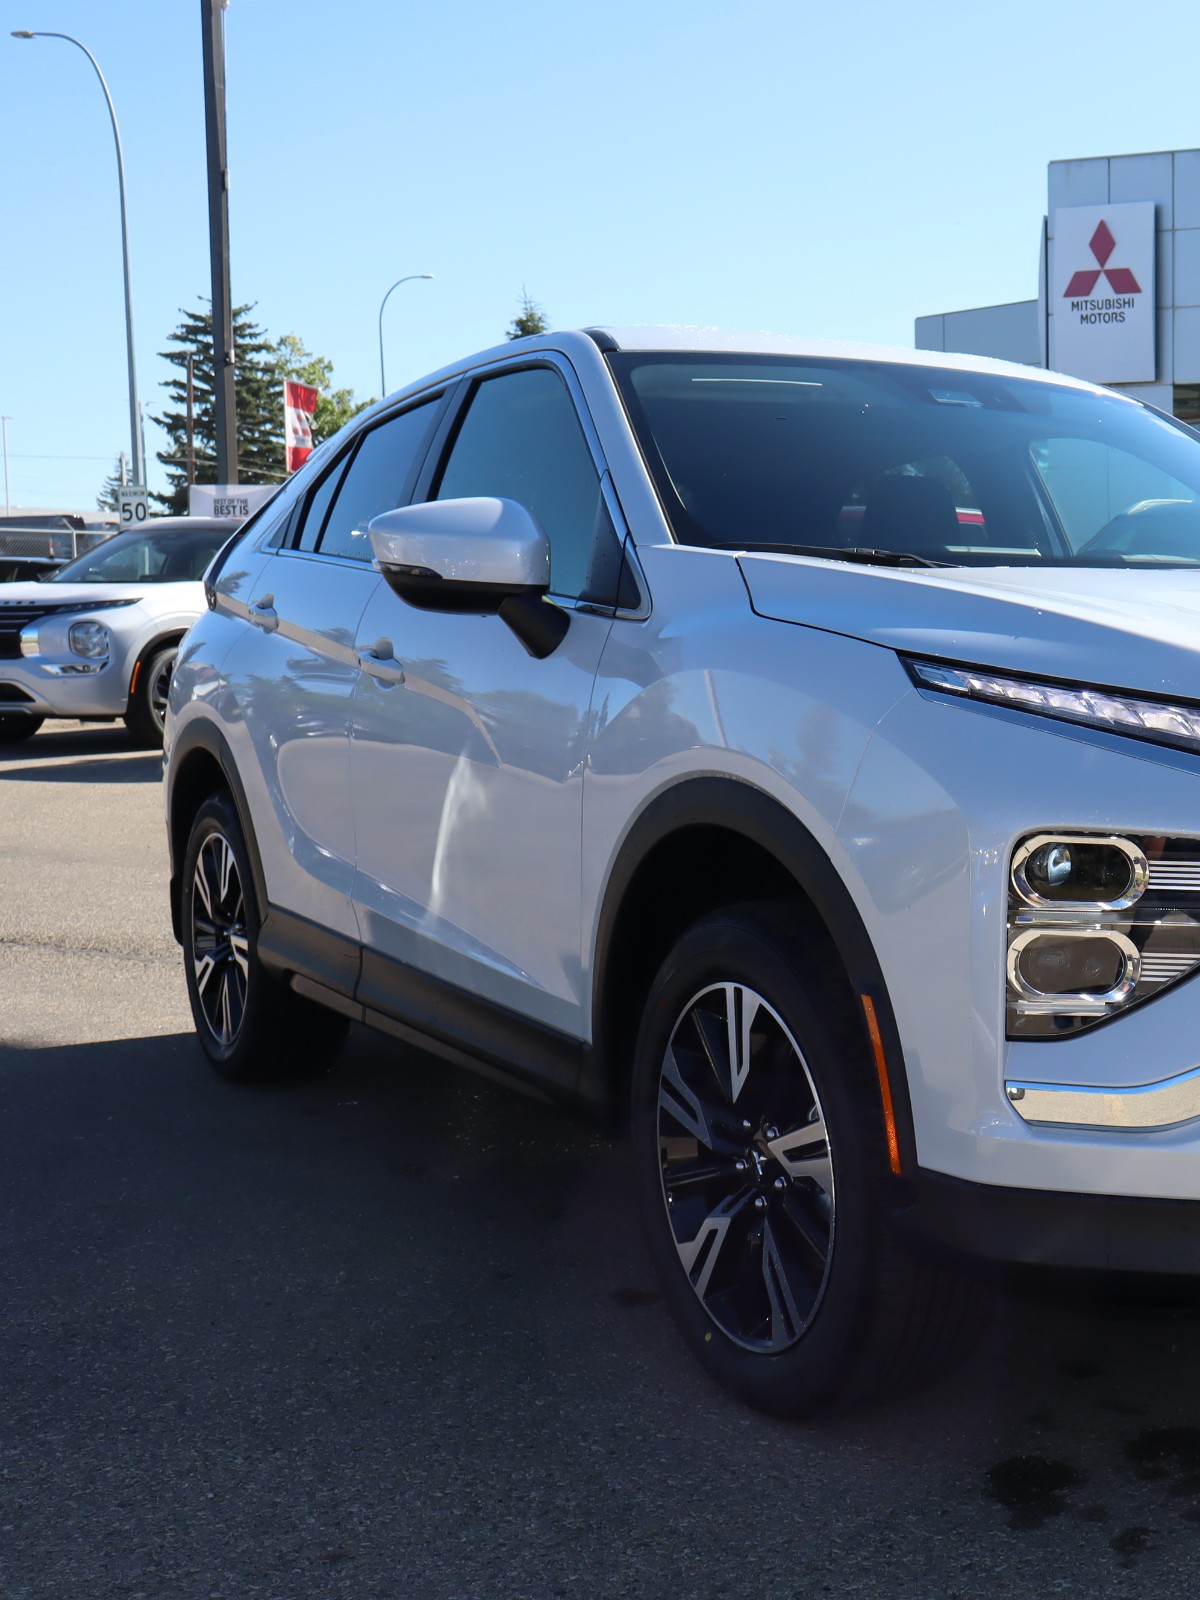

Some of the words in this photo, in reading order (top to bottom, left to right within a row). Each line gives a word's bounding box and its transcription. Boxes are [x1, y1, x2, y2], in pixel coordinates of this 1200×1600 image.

[1071, 297, 1135, 312] MITSUBISHI
[1080, 311, 1126, 325] MOTORS
[214, 498, 227, 506] BEST
[236, 498, 249, 506] THE
[122, 502, 147, 521] 50
[214, 505, 238, 515] BEST
[240, 505, 249, 515] IS
